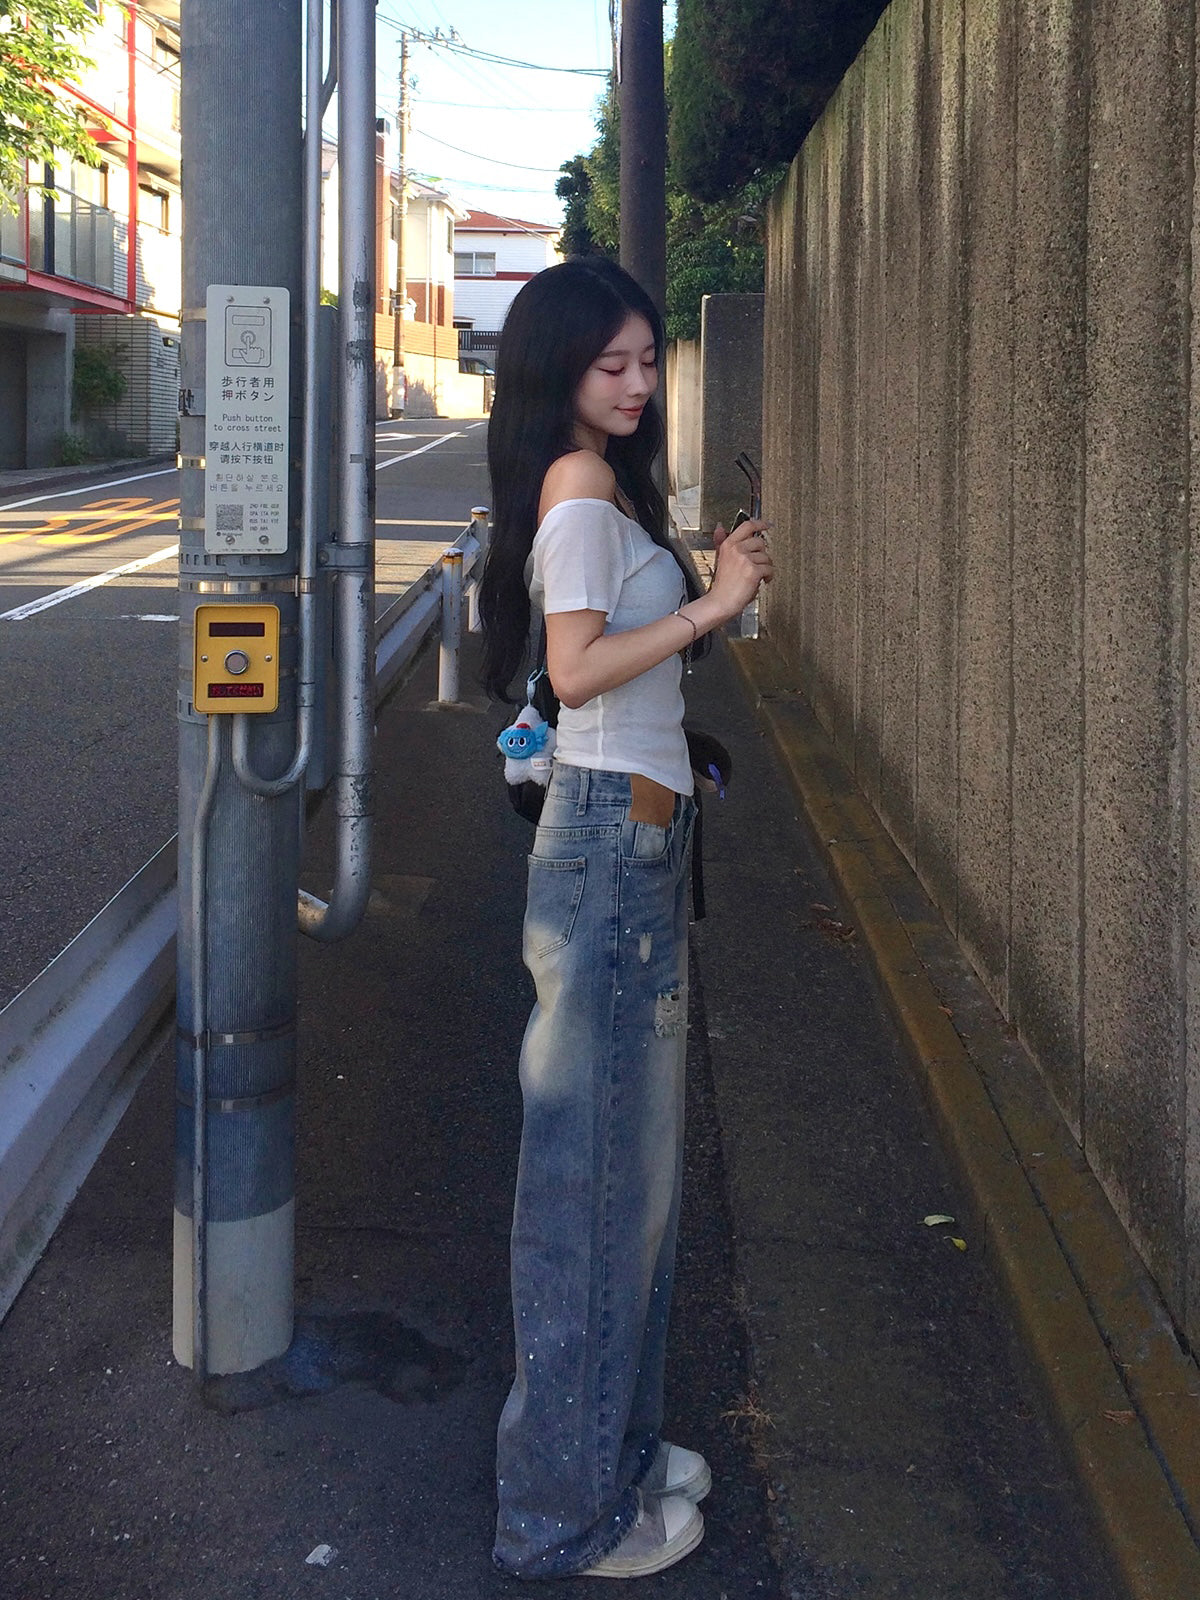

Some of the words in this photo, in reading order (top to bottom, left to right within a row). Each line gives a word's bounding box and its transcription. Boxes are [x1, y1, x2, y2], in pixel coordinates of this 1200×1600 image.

[221, 376, 275, 388] 歩行者用
[222, 389, 274, 401] 押ボタン
[222, 413, 241, 422] Push
[209, 441, 284, 452] 穿越人行横道时
[220, 454, 274, 465] 请按下按钮
